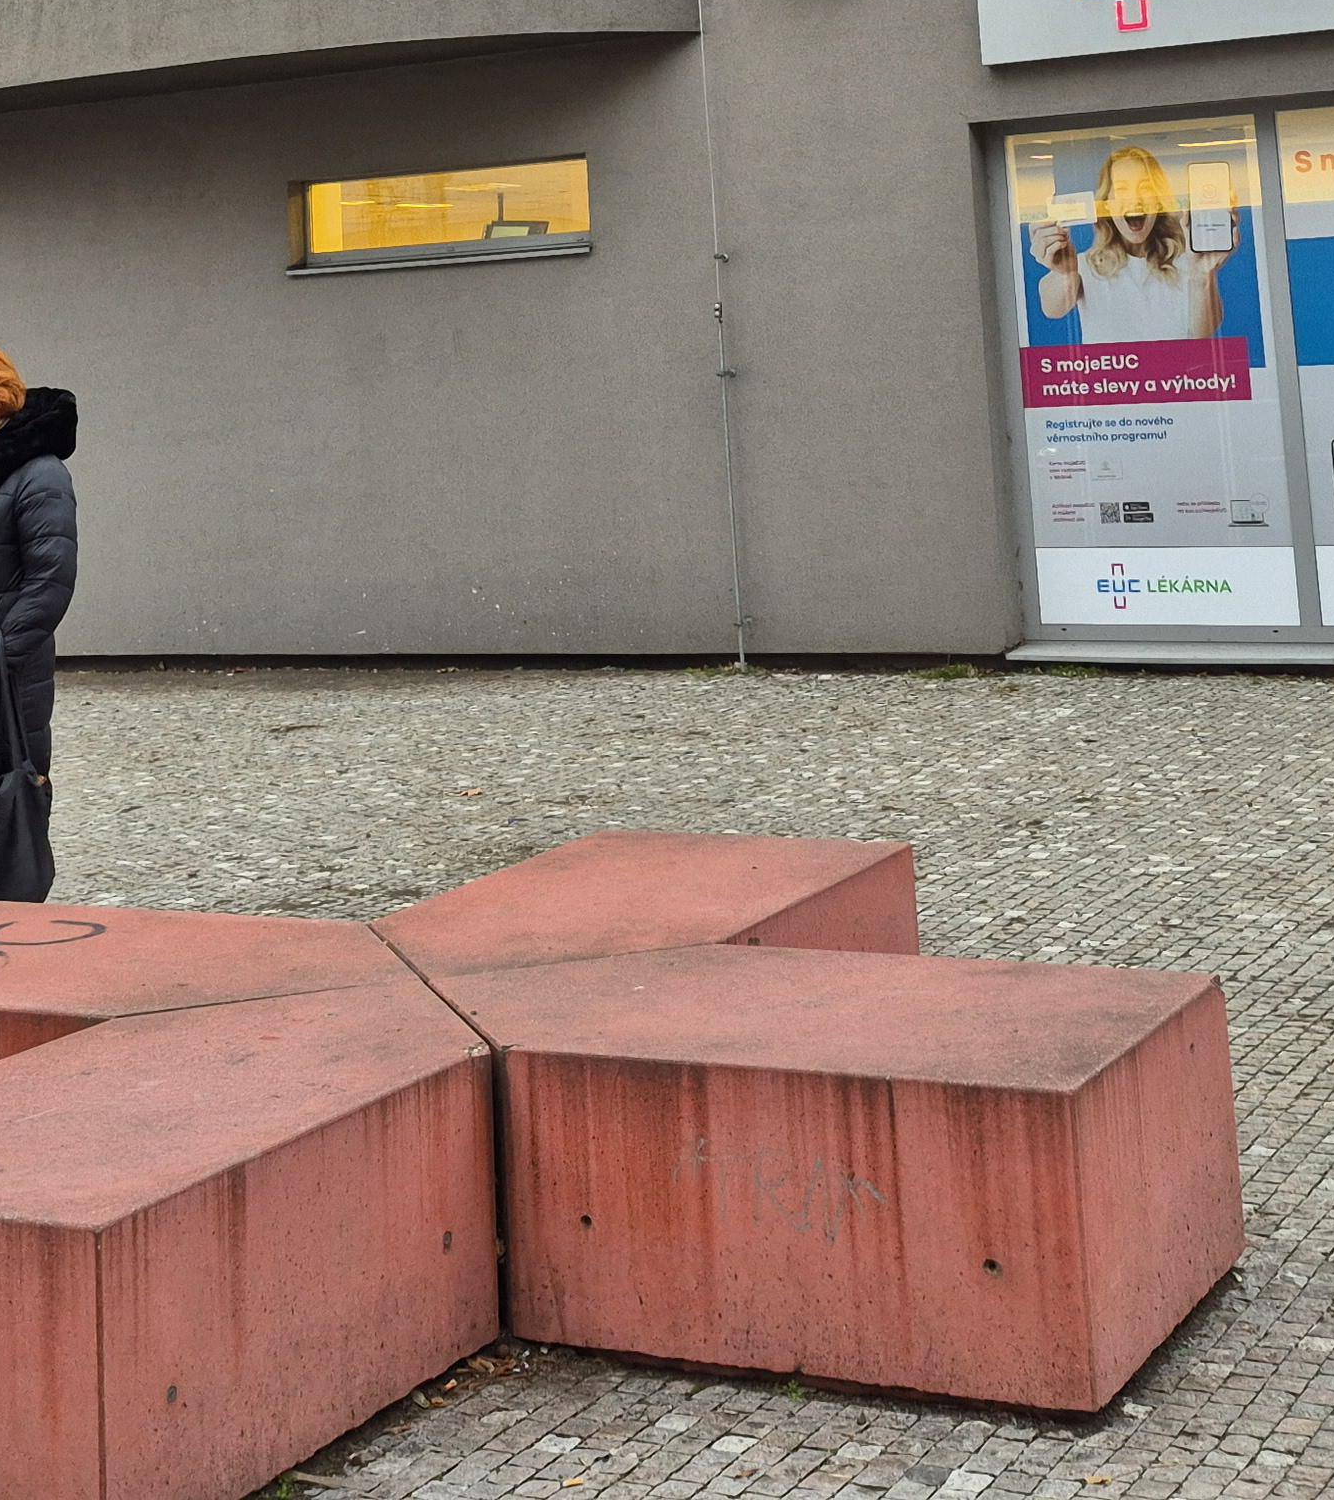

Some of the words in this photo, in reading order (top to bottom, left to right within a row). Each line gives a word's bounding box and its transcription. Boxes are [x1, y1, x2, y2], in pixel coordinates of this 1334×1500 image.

[1294, 150, 1313, 173] S
[1041, 358, 1052, 373] S
[1056, 354, 1140, 374] mojeEUC
[1042, 379, 1090, 396] máte
[1093, 378, 1140, 396] slevy
[1144, 381, 1157, 392] a
[1161, 373, 1236, 394] výhody!
[1045, 419, 1103, 435] Registrujte
[1104, 419, 1117, 428] se
[1119, 417, 1133, 428] do
[1135, 416, 1174, 428] nového
[1046, 431, 1109, 444] věrnostního
[1110, 430, 1167, 446] programu!
[1097, 579, 1141, 593] EUC
[1146, 575, 1232, 593] LÉKÁRNA
